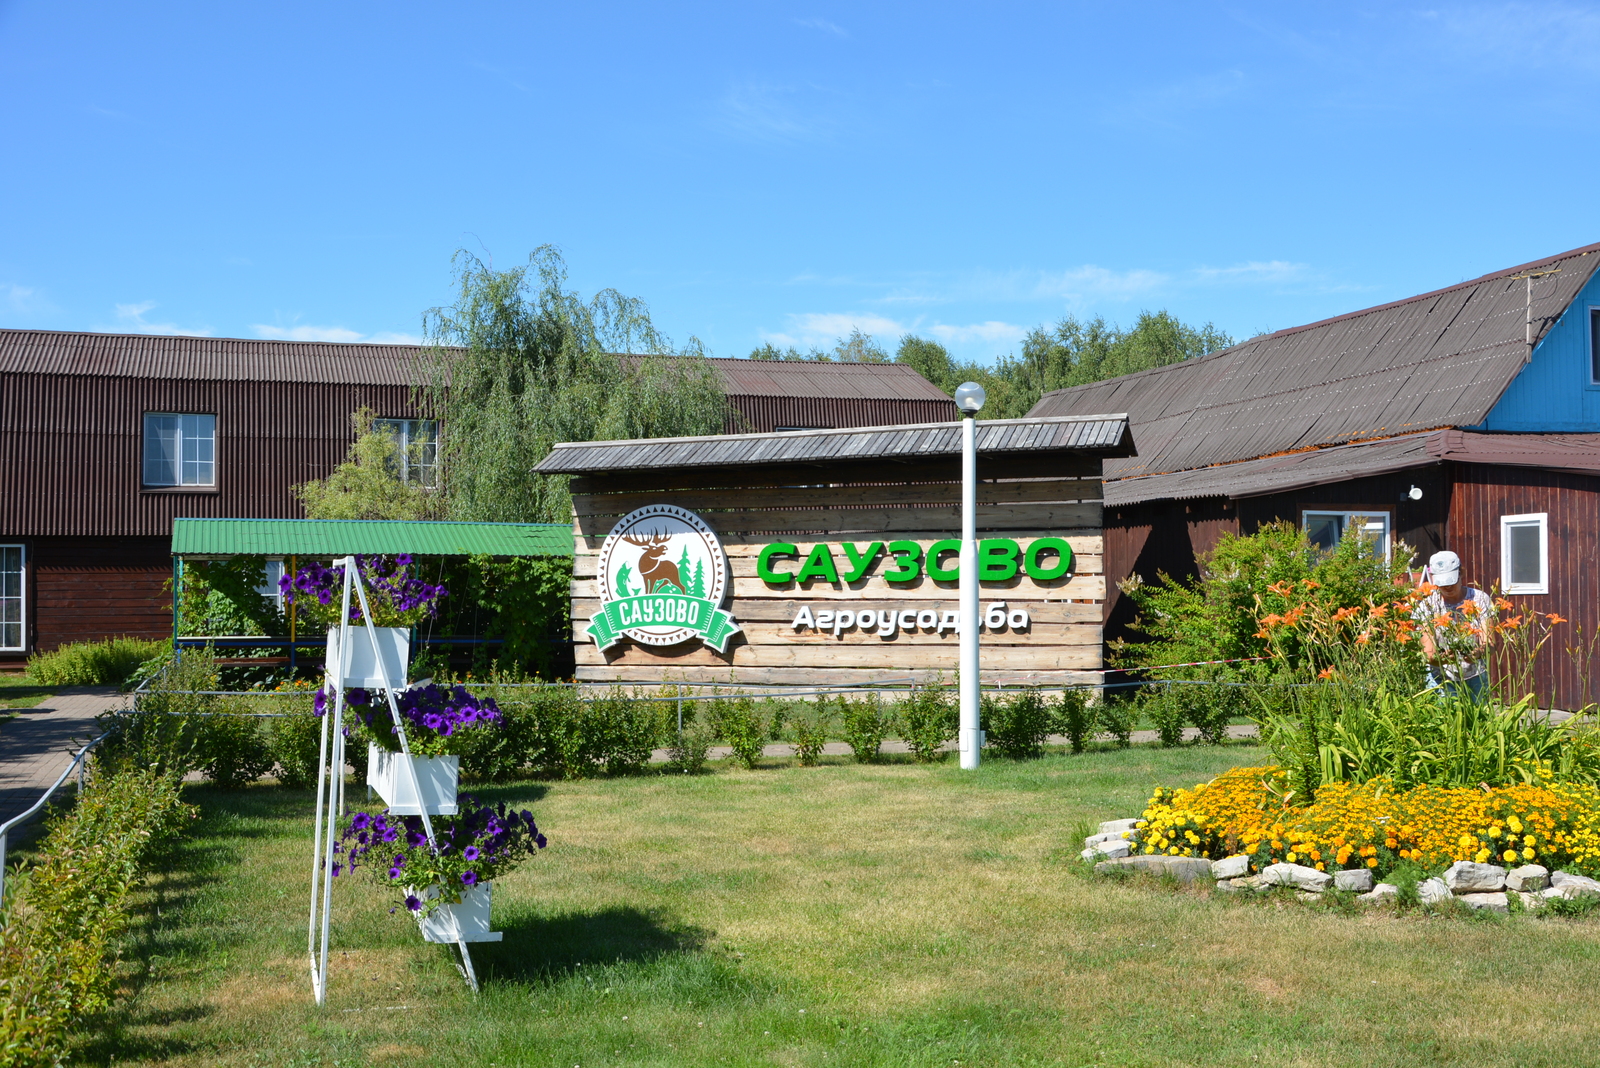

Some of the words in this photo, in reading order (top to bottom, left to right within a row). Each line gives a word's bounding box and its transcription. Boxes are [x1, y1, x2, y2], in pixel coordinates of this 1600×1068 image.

[757, 537, 1073, 584] САУЗОВО
[618, 598, 700, 626] САУЗОВО
[791, 601, 1029, 637] Агроусадба
